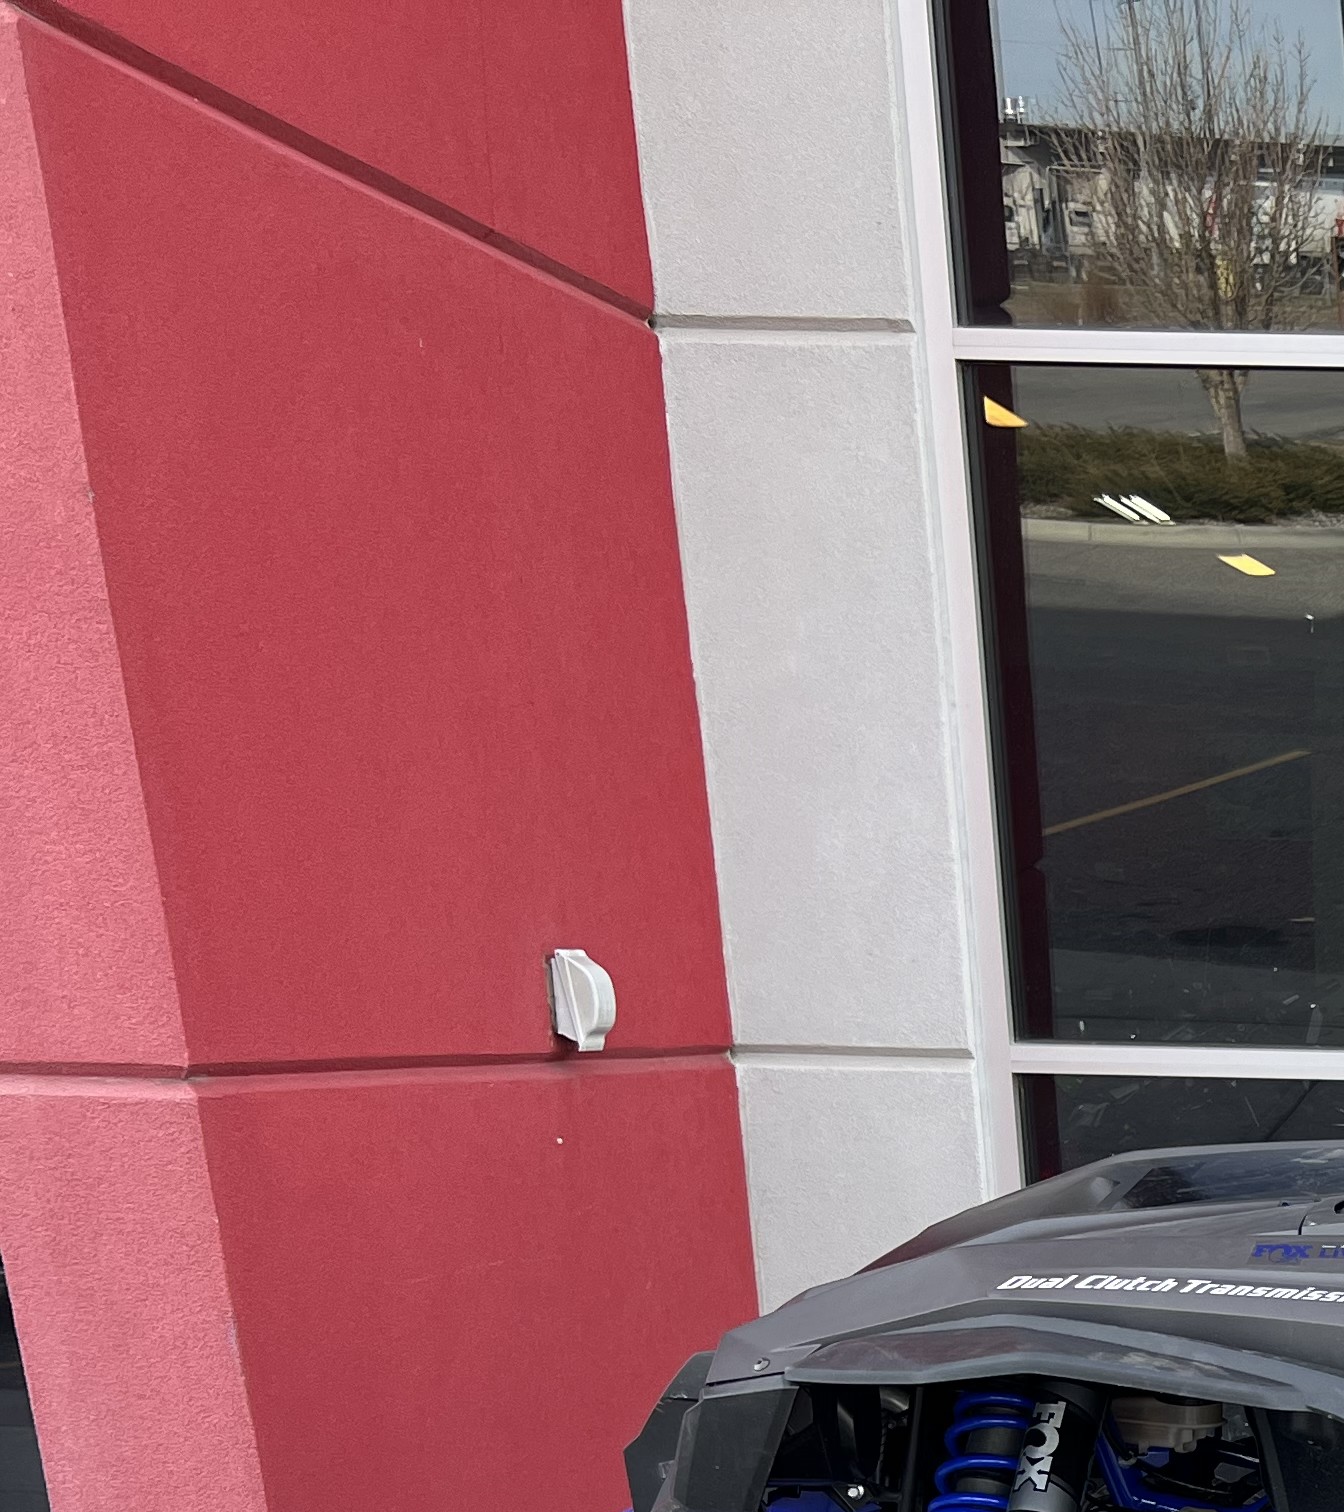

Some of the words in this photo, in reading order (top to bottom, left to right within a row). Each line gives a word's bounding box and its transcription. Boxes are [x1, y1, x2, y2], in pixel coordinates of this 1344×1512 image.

[1252, 1243, 1314, 1263] FOX
[997, 1274, 1074, 1291] Dual
[1073, 1274, 1179, 1293] Clutch
[1013, 1400, 1067, 1491] FOX
